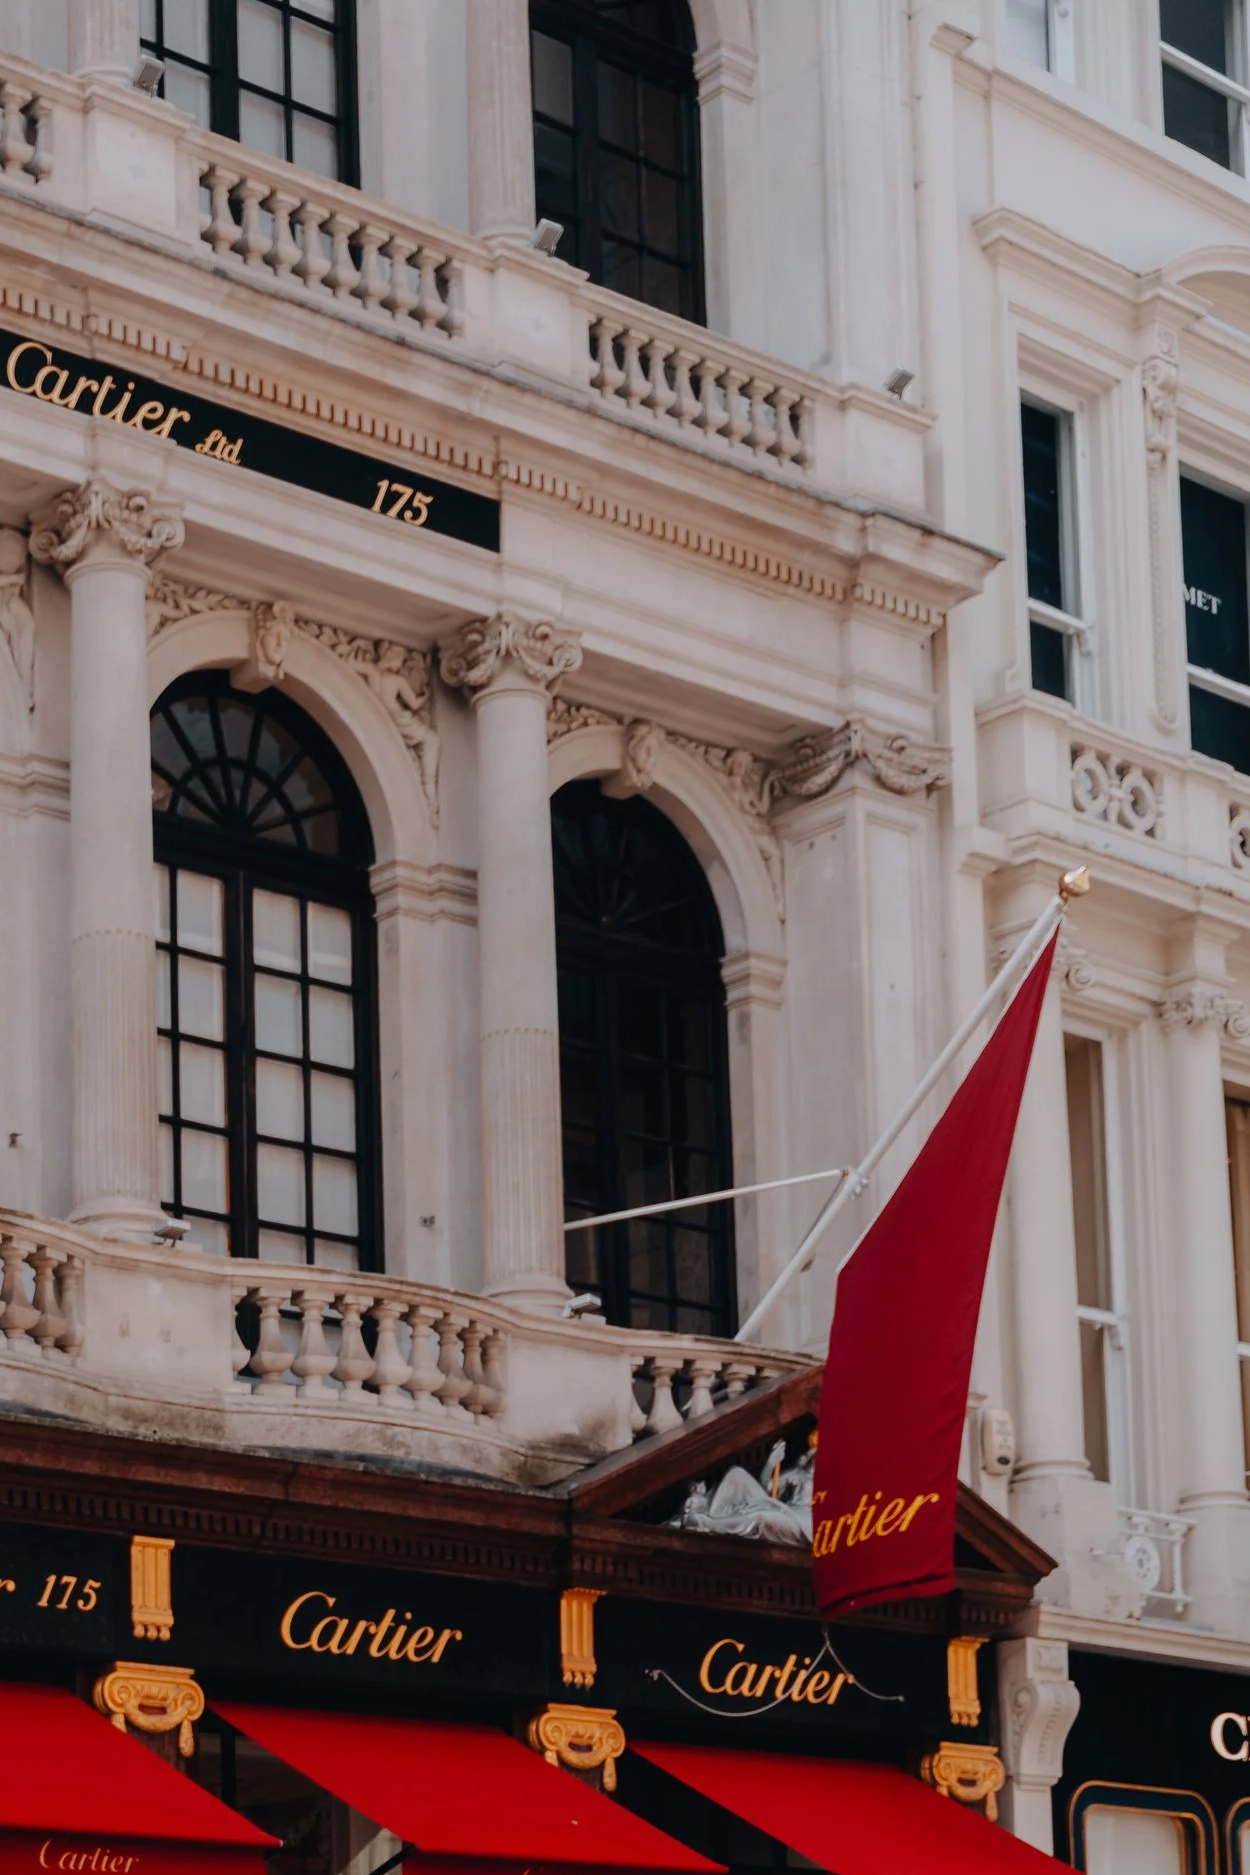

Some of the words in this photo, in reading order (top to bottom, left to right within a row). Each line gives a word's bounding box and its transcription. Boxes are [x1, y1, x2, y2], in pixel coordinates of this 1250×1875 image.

[6, 341, 191, 439] Cartier
[195, 429, 244, 465] Ltd
[368, 478, 434, 527] 175
[812, 1489, 941, 1558] artier
[37, 1574, 102, 1612] 175
[280, 1591, 463, 1663] Cartier
[699, 1638, 856, 1705] Cartier
[1210, 1711, 1250, 1762] C
[39, 1840, 140, 1874] Cartier
